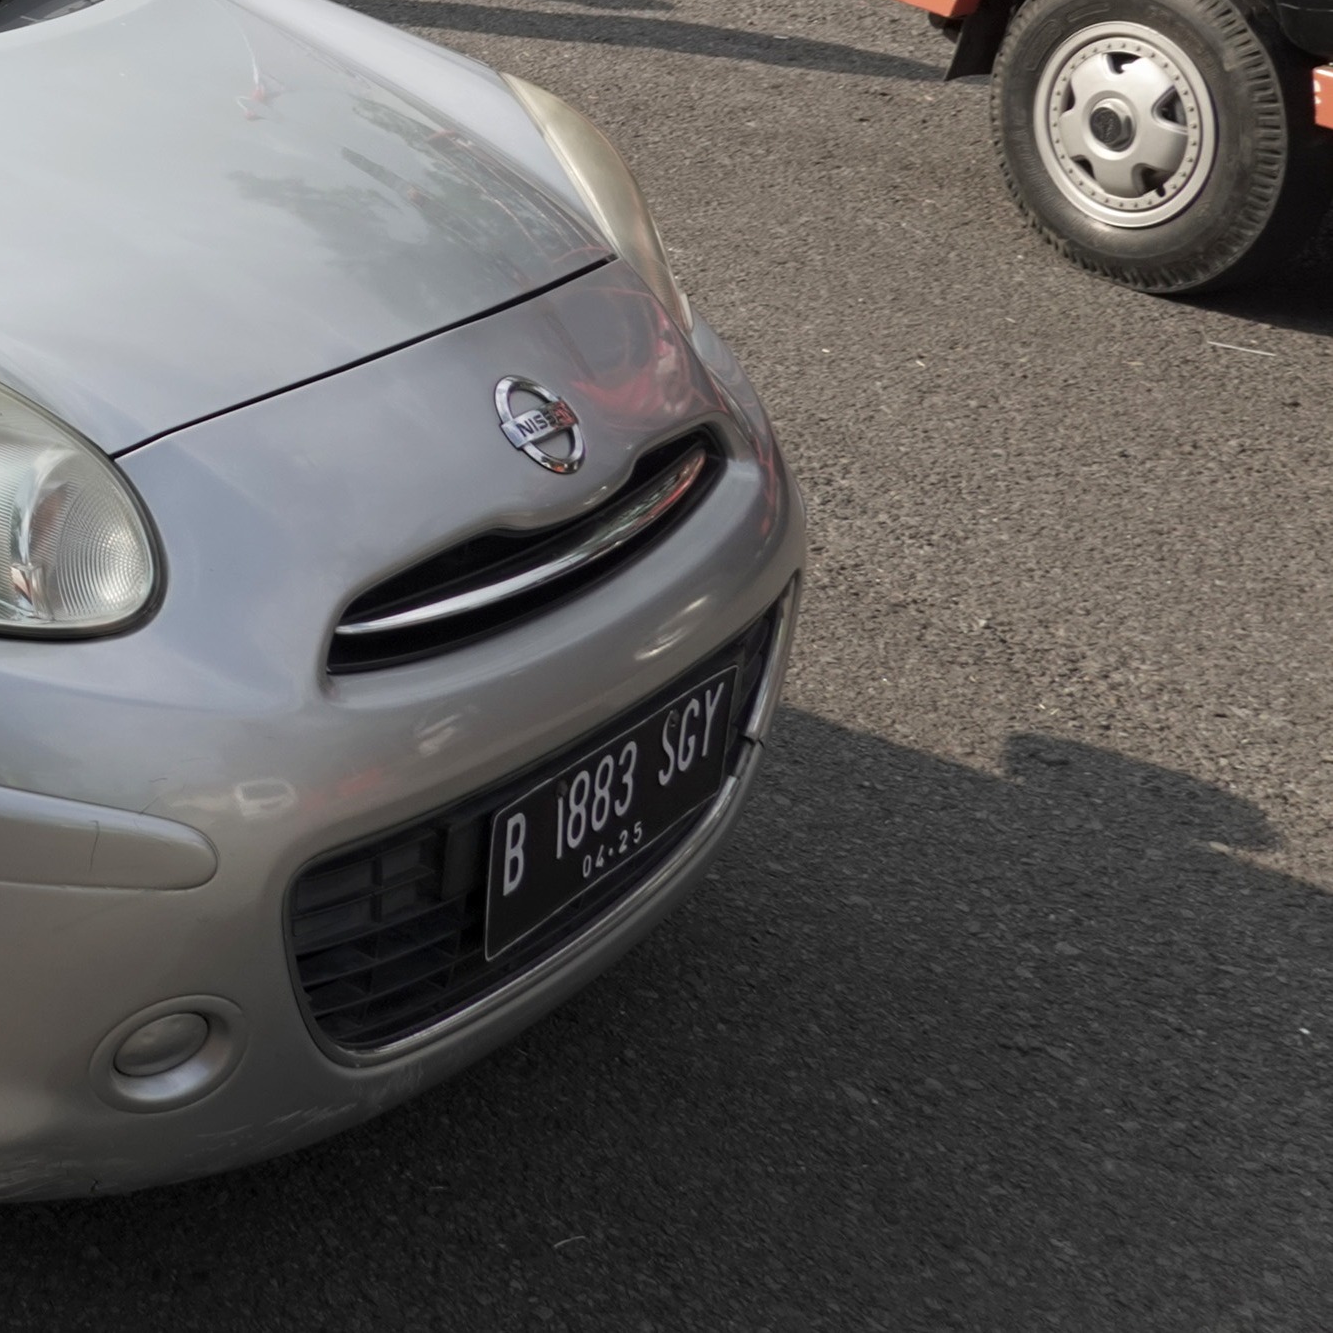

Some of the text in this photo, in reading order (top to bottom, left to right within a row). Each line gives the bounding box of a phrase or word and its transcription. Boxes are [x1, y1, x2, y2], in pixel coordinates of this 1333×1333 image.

[502, 681, 725, 897] B 1883 SGY
